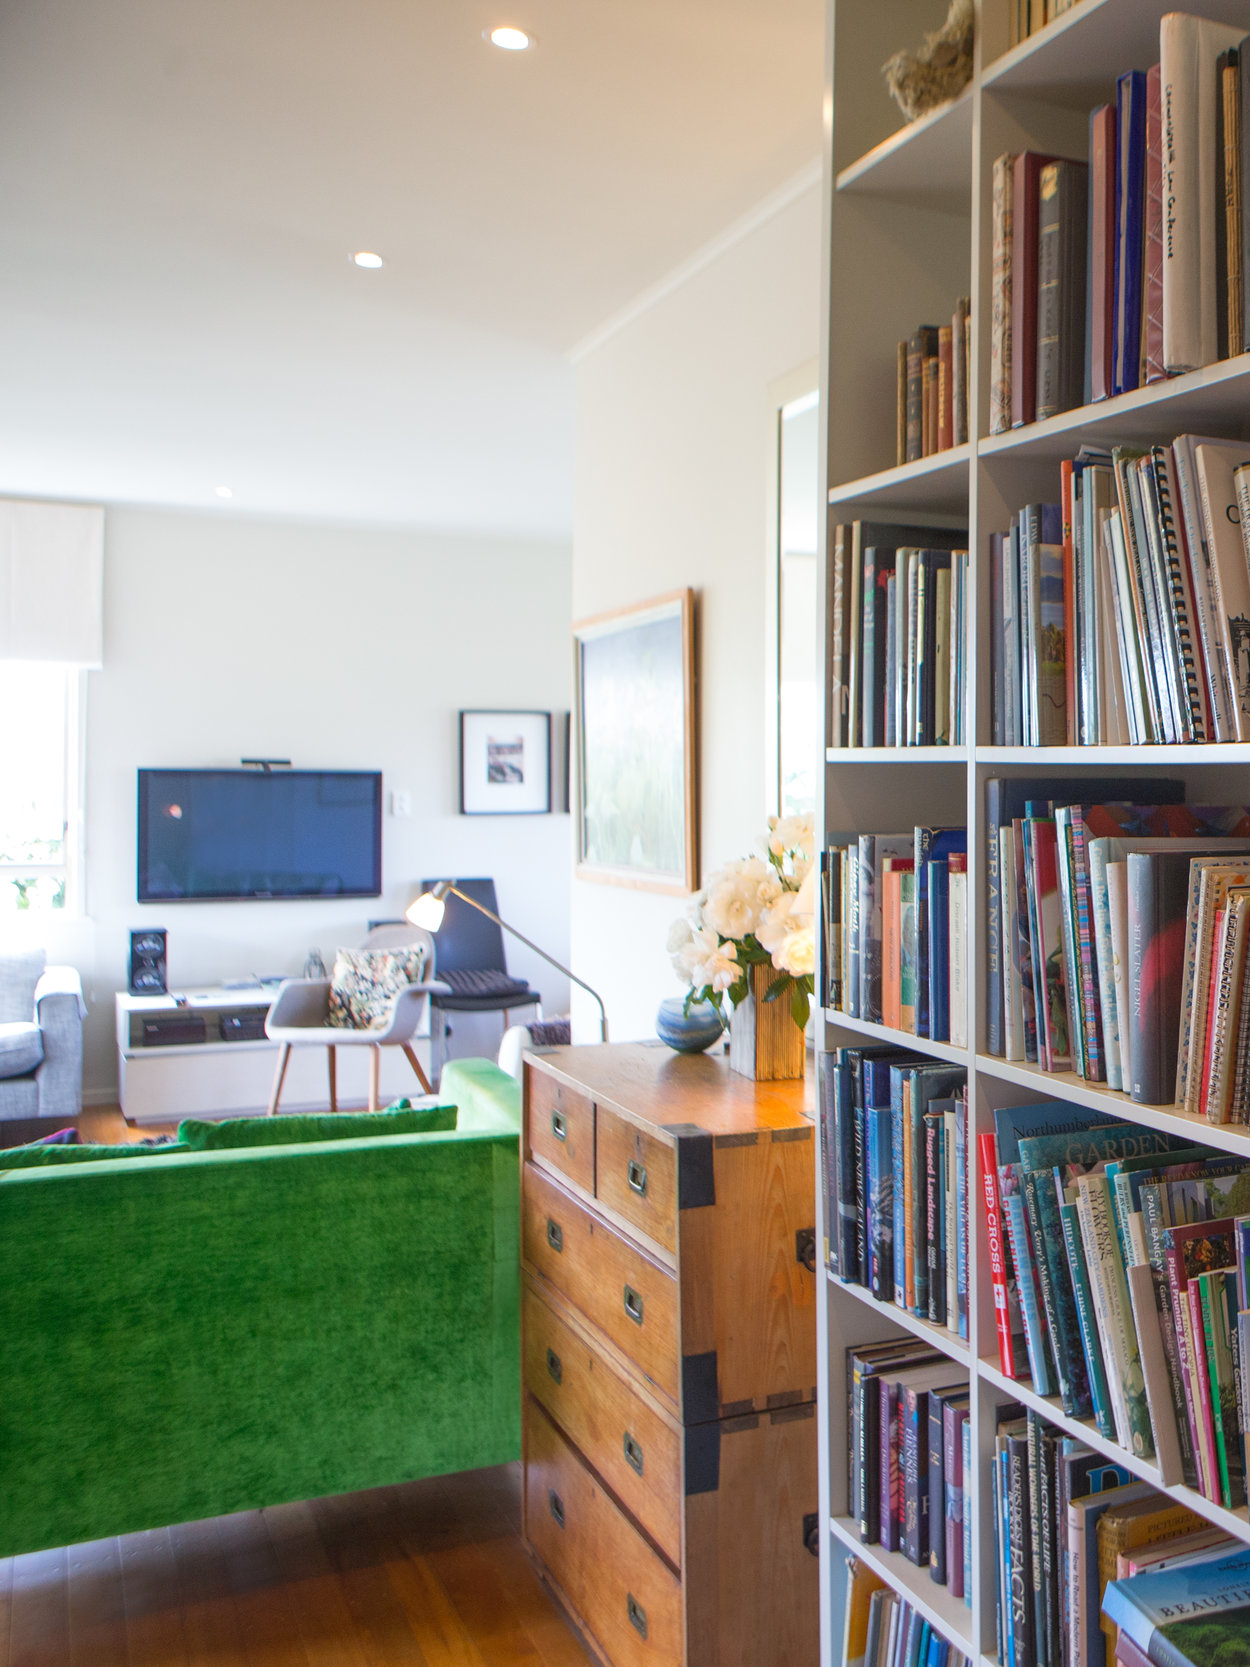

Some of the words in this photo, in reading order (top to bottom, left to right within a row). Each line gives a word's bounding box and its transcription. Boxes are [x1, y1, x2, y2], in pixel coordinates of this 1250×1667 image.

[1240, 484, 1250, 508] THE
[832, 543, 844, 695] MANDELA
[986, 832, 999, 971] FRANCE
[1093, 885, 1107, 929] Recipes
[1133, 924, 1142, 972] SLATER
[1133, 974, 1142, 1017] NIGEL
[854, 1119, 864, 1157] WILD
[926, 1127, 936, 1174] Rugged
[1065, 1133, 1171, 1164] GARDEN
[855, 1159, 864, 1193] NEW
[983, 1174, 996, 1209] RED
[1079, 1184, 1090, 1205] NEW
[926, 1176, 937, 1240] Landscape
[1024, 1182, 1039, 1226] Rosemary
[1095, 1189, 1106, 1208] MY
[1121, 1207, 1129, 1220] and
[1146, 1194, 1157, 1224] PAUL
[856, 1194, 865, 1262] ZEALAND
[986, 1212, 1001, 1275] CROSS
[1010, 1197, 1030, 1270] MATTHEW
[1063, 1217, 1080, 1270] HIDCOTE
[1083, 1207, 1096, 1250] ZEALAND
[1088, 1189, 1107, 1261] FLOWERS
[1097, 1212, 1111, 1246] BOOK
[960, 1242, 966, 1258] OF
[1033, 1229, 1047, 1262] Verey's
[1091, 1251, 1101, 1273] CITY
[1039, 1263, 1052, 1302] Making
[1167, 1257, 1177, 1285] Plant
[1045, 1304, 1054, 1315] of
[1095, 1274, 1108, 1319] GARDENS
[1159, 1284, 1169, 1320] Garden
[1171, 1288, 1184, 1332] Pruning
[1050, 1323, 1061, 1359] Garden
[1163, 1322, 1175, 1357] Design
[1178, 1335, 1186, 1345] A
[1180, 1346, 1187, 1359] to
[1230, 1326, 1240, 1366] Yates
[1182, 1361, 1190, 1370] Z
[1185, 1340, 1196, 1377] UTOPIA
[1170, 1357, 1183, 1409] Handbook
[1233, 1367, 1243, 1404] Garden
[880, 1391, 888, 1433] Through
[1236, 1405, 1245, 1435] Guide
[905, 1427, 914, 1485] FIENNES
[1027, 1421, 1037, 1467] NATURAL
[1012, 1455, 1024, 1505] READER'S
[1029, 1468, 1040, 1517] WONDERS
[1040, 1471, 1050, 1518] FACTS
[1013, 1505, 1024, 1546] DIGEST
[1031, 1518, 1040, 1533] OF
[1031, 1534, 1041, 1553] THE
[1042, 1518, 1051, 1541] OF
[1032, 1554, 1042, 1592] WORLD
[1043, 1541, 1052, 1574] LIFE
[1072, 1552, 1080, 1572] How
[1009, 1545, 1025, 1625] FACTS
[1073, 1574, 1080, 1583] to
[1073, 1584, 1081, 1607] Read
[1217, 1581, 1250, 1593] LONELY
[1073, 1615, 1081, 1648] Modern
